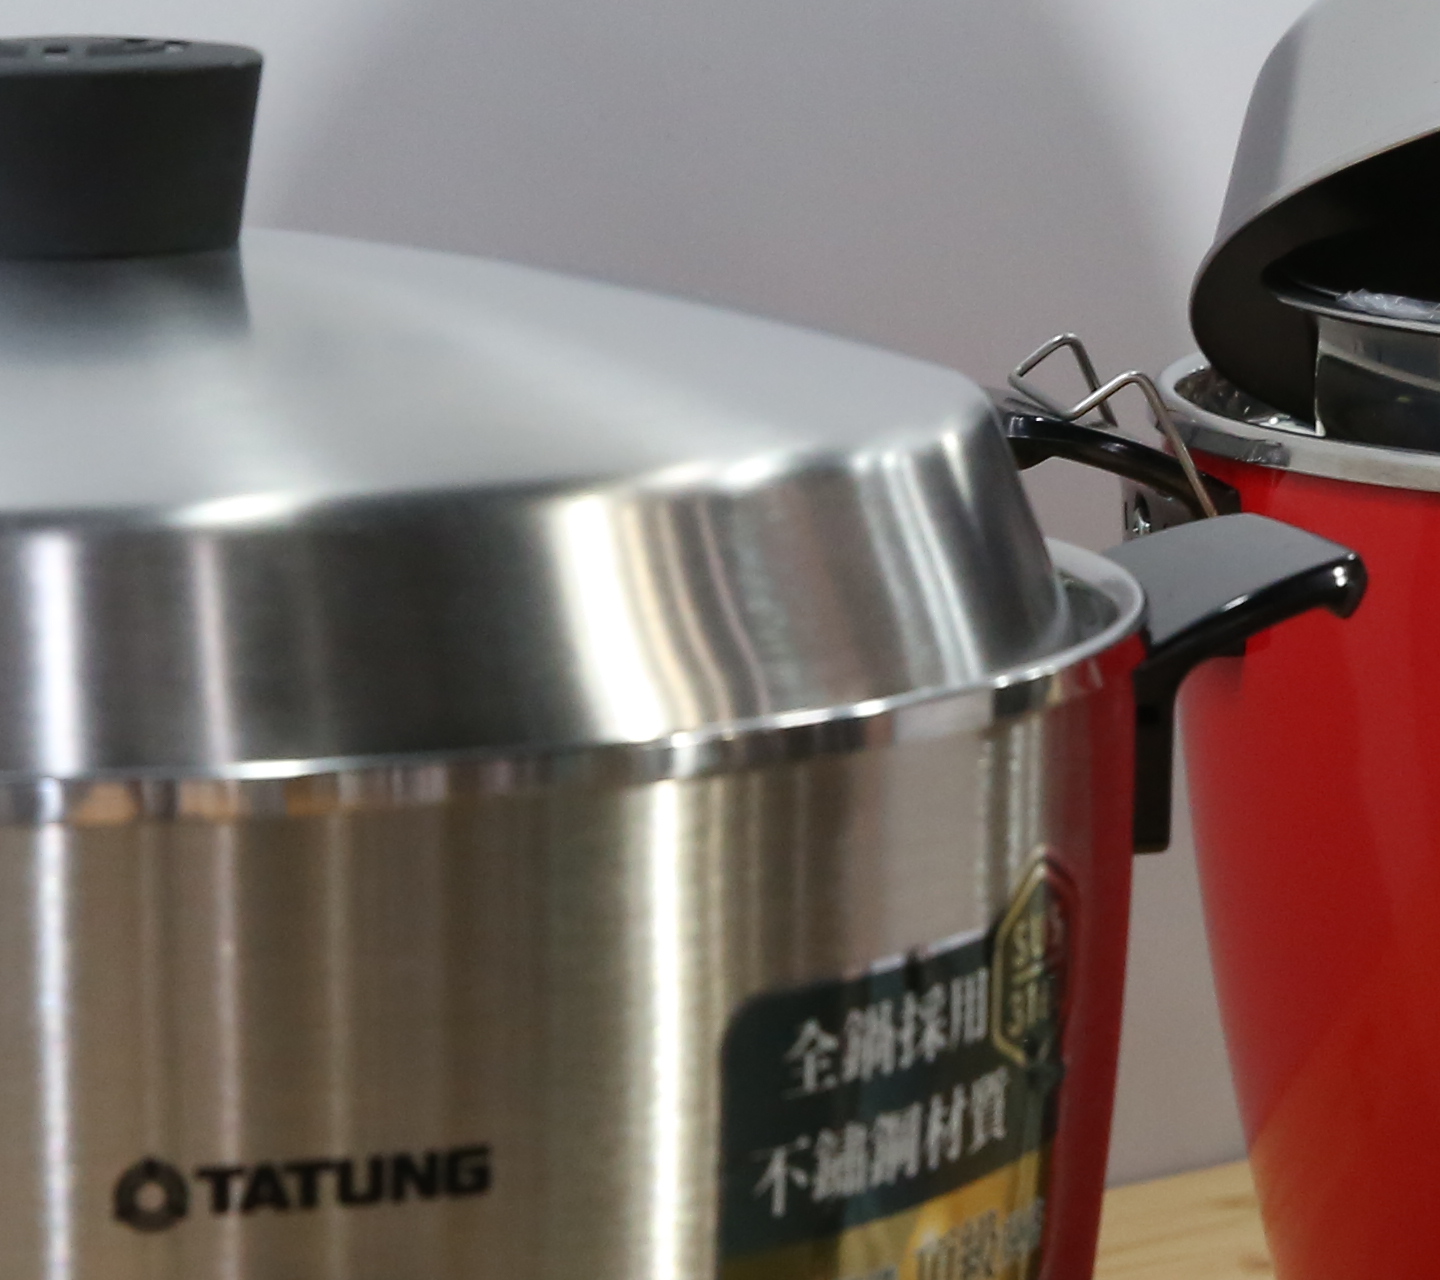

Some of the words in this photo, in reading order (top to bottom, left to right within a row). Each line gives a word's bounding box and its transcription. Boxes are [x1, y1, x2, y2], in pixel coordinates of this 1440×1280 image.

[784, 965, 989, 1100] 全鍋採用
[194, 1143, 491, 1216] TATUNG
[753, 1066, 1009, 1217] 不鏽鋼材質
